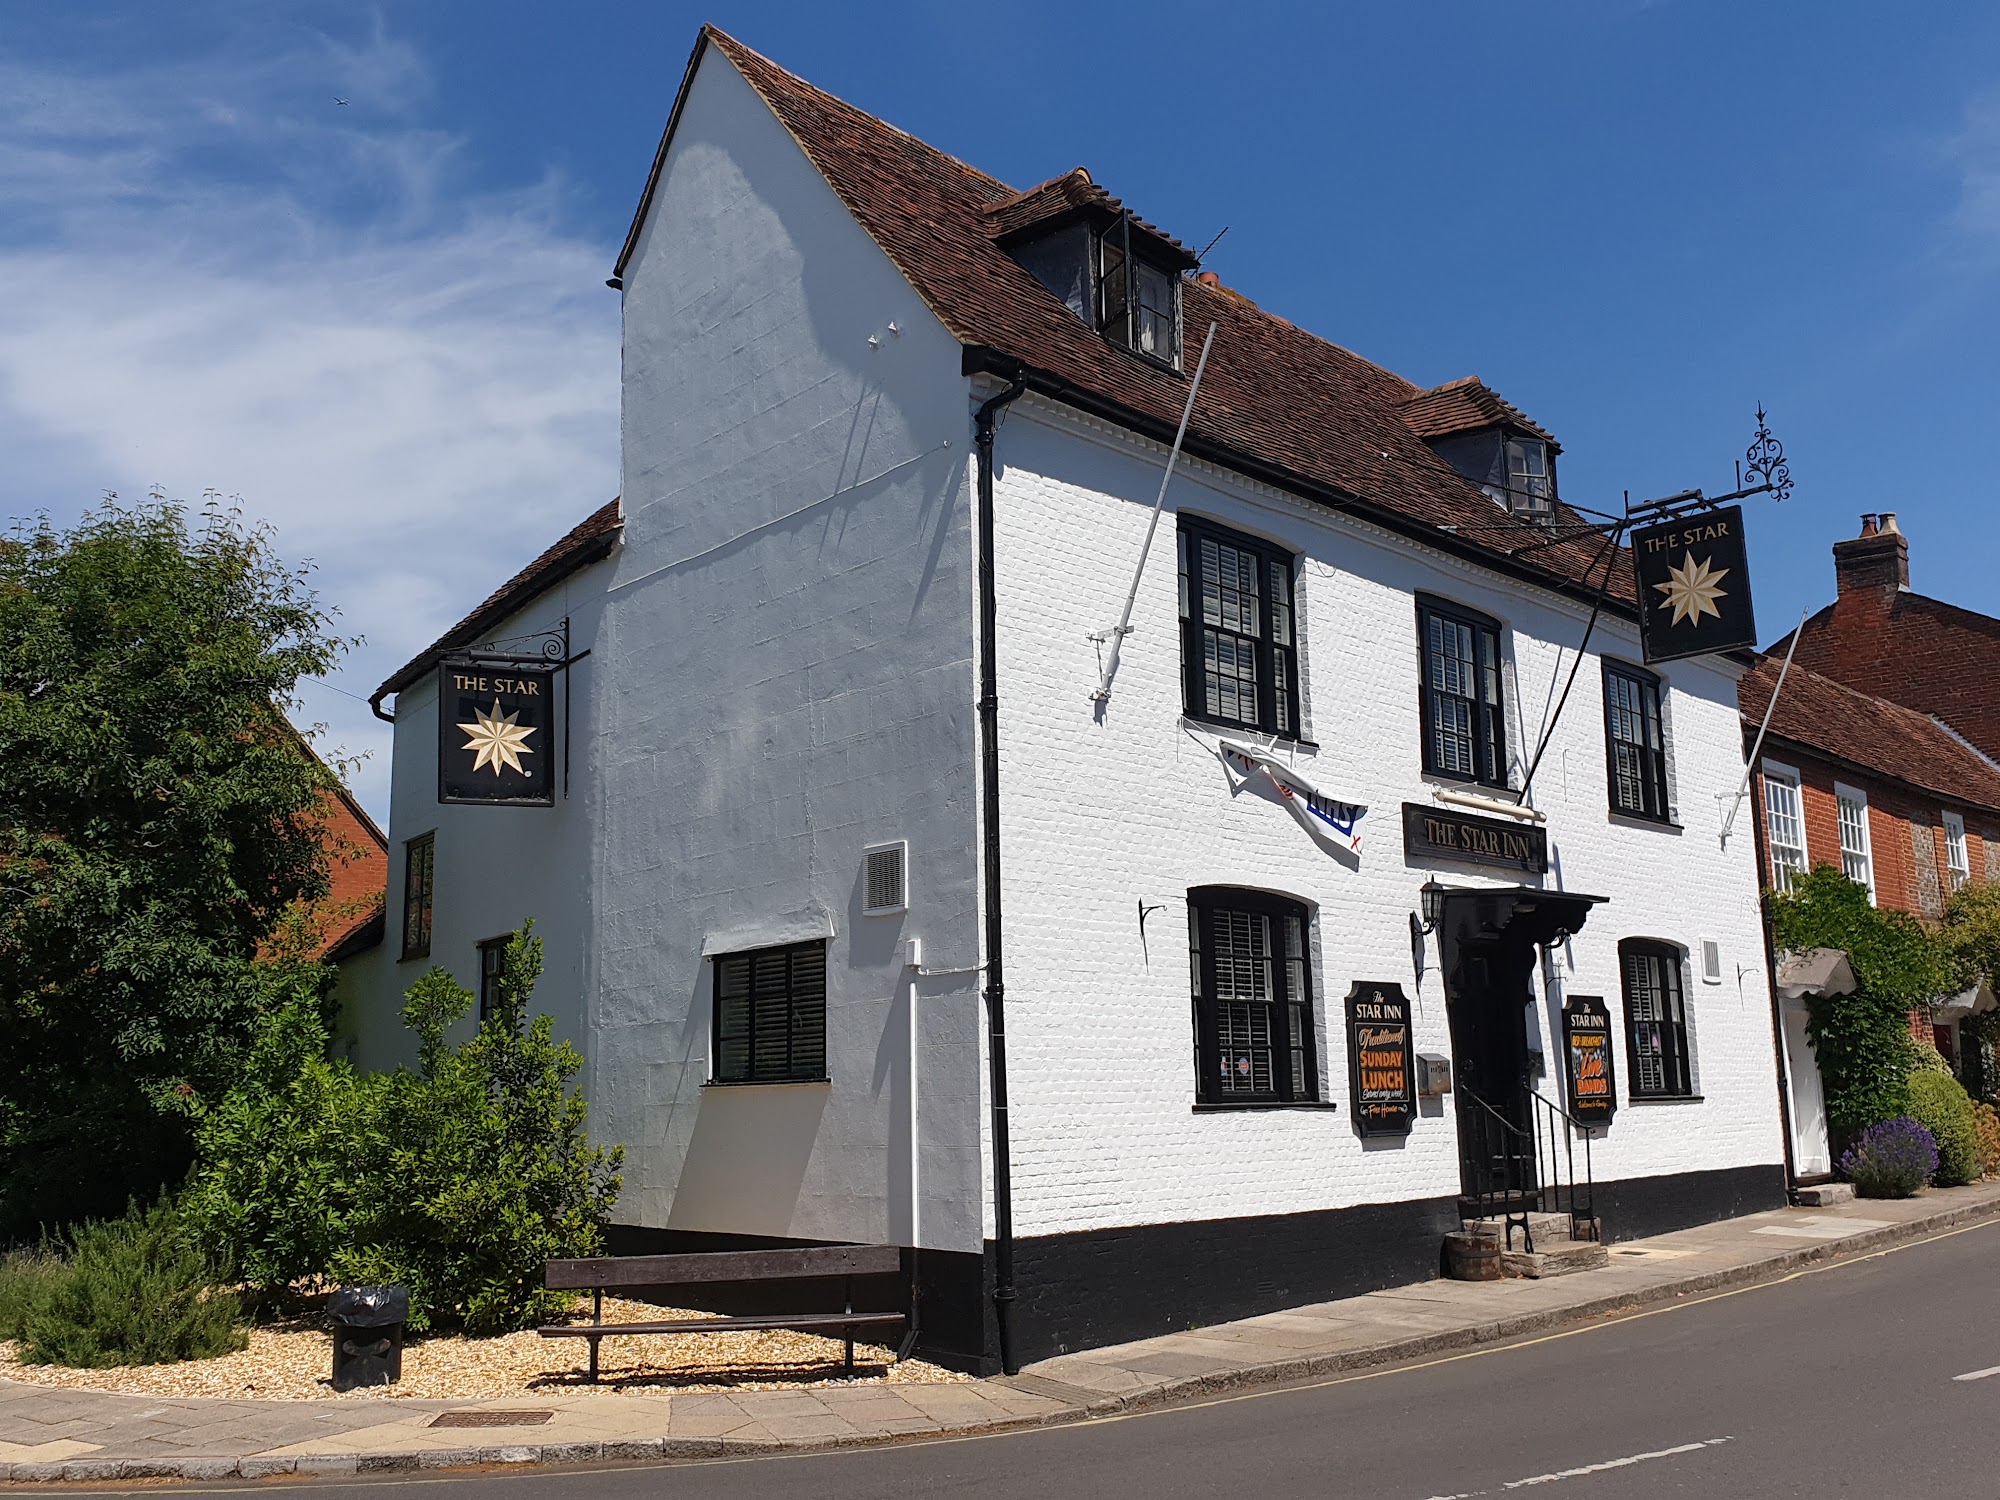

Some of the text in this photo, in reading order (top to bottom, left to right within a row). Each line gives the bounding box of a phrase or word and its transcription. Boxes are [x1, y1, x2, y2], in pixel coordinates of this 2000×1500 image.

[1645, 522, 1729, 553] THE STAR
[453, 675, 540, 696] THE STAR
[1424, 818, 1529, 858] THE STAR INN
[1372, 991, 1384, 1003] The
[1356, 1003, 1402, 1019] STAR INN
[1583, 1003, 1591, 1013] The
[1571, 1014, 1604, 1027] STAR INN
[1359, 1027, 1404, 1049] Traditional
[1360, 1050, 1403, 1067] SUNDAY
[1581, 1055, 1602, 1079] Live
[1362, 1070, 1404, 1089] LUNCH
[1577, 1078, 1607, 1095] BANDS
[1368, 1103, 1398, 1119] Free House
